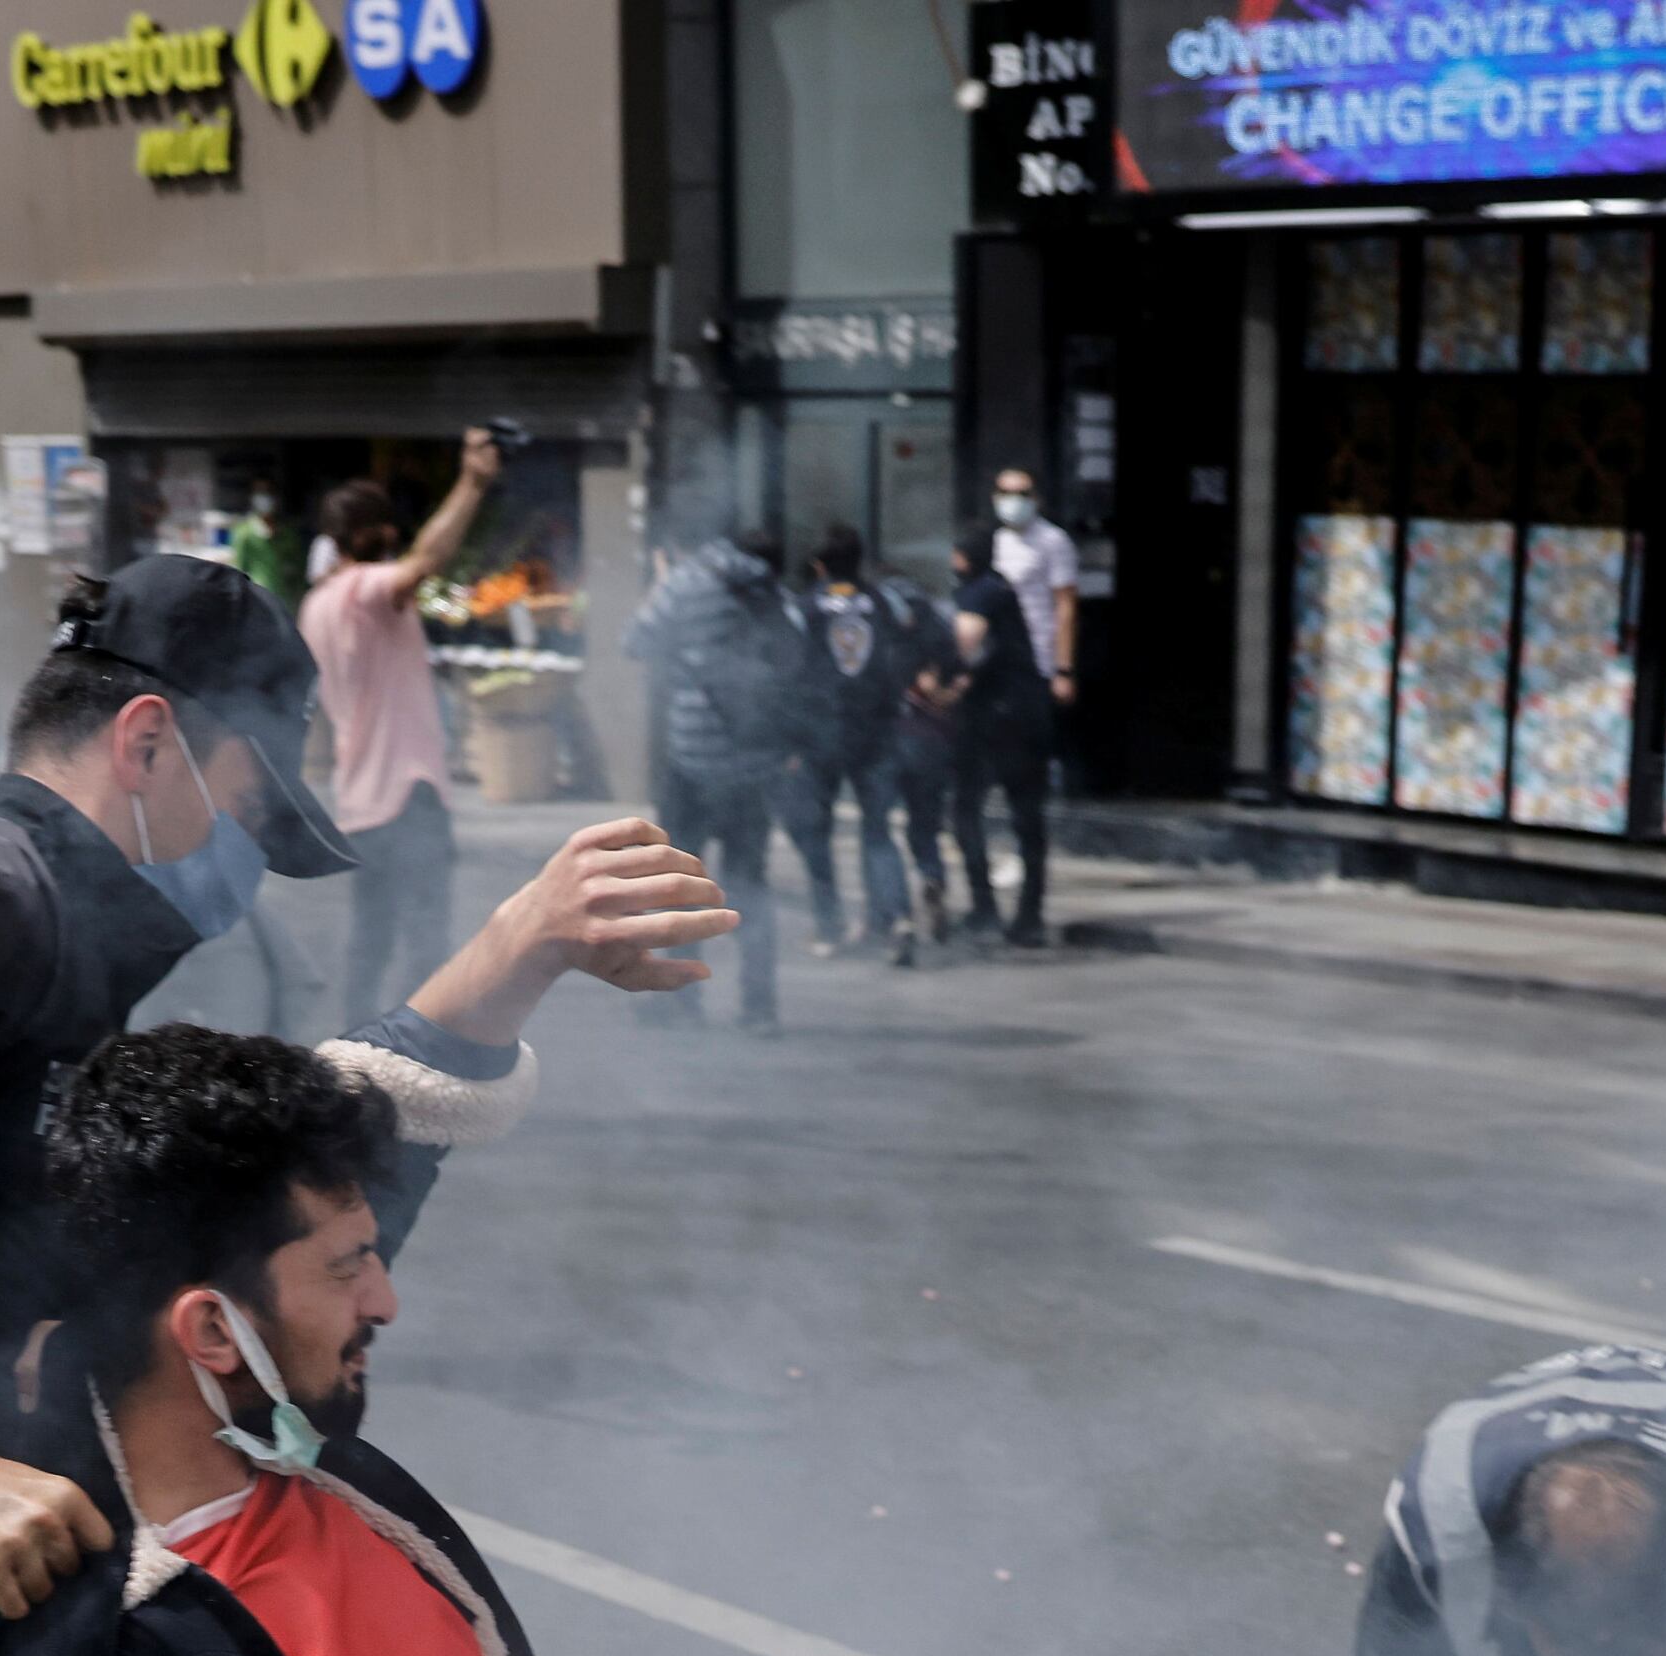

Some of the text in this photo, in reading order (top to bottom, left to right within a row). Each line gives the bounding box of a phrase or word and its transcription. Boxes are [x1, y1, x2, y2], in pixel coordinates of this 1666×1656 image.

[12, 0, 472, 106] Carrefour SA
[1167, 8, 1400, 80] GÜVENDİK
[1407, 3, 1553, 61] DÖVİZ
[1563, 9, 1617, 50] ve
[136, 107, 231, 177] mini
[1224, 81, 1468, 154] CHANGE
